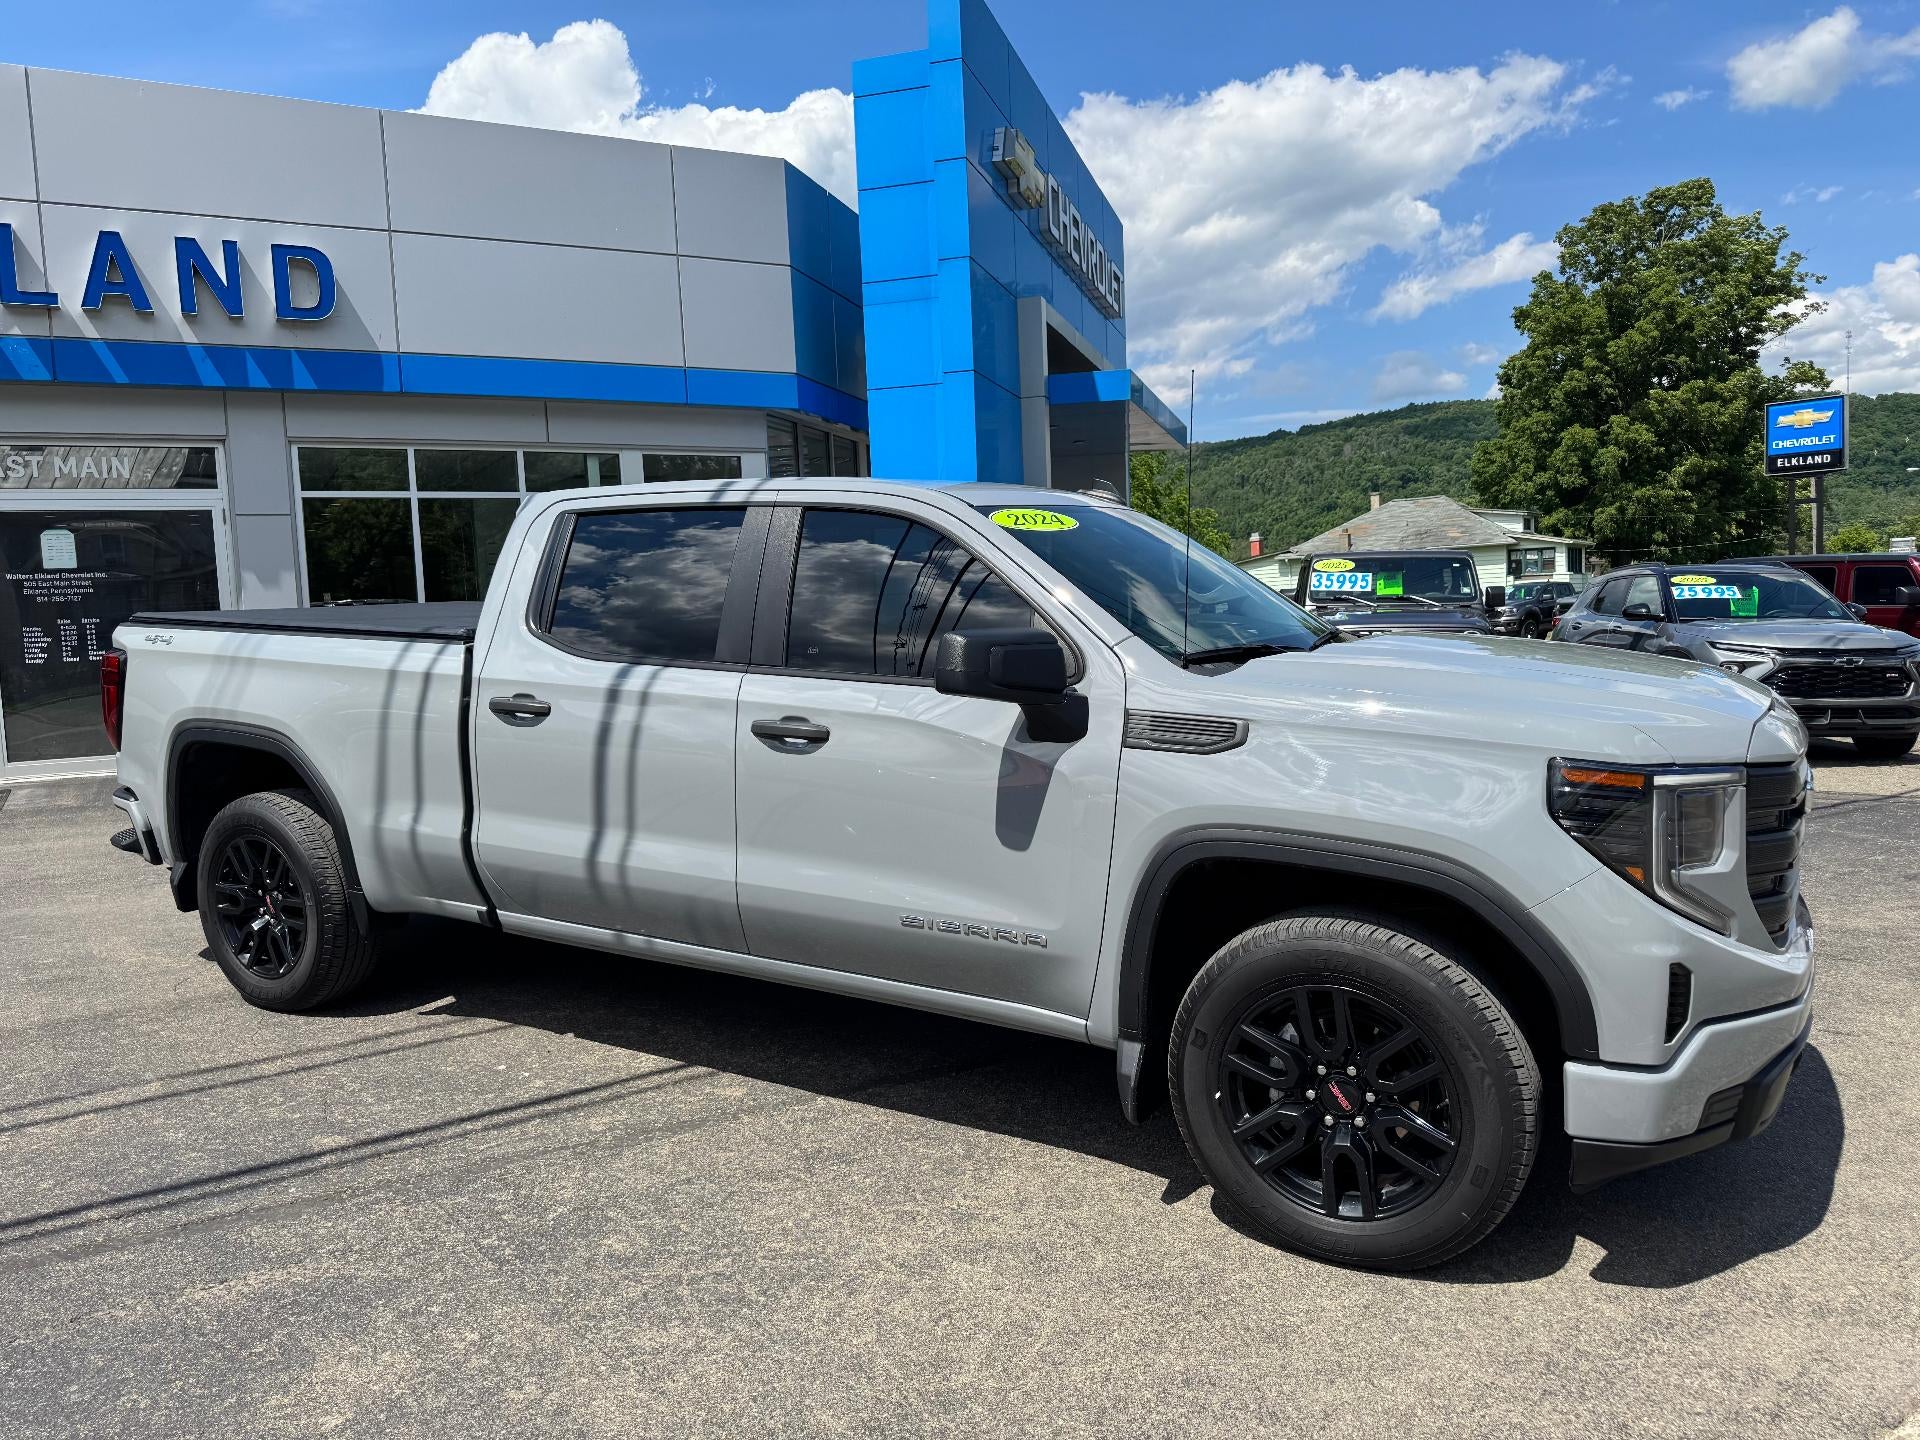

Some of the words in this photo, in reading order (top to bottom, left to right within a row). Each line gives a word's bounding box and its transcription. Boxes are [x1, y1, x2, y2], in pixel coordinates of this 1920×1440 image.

[1044, 172, 1124, 319] CHEVROLET
[1772, 434, 1836, 449] CHEVROLET
[53, 456, 130, 479] MAIN
[1777, 454, 1831, 467] ELKLAND
[1006, 513, 1066, 526] 2024
[1312, 573, 1370, 590] 35995
[1674, 586, 1737, 598] 25995
[899, 913, 1048, 950] SIERRA
